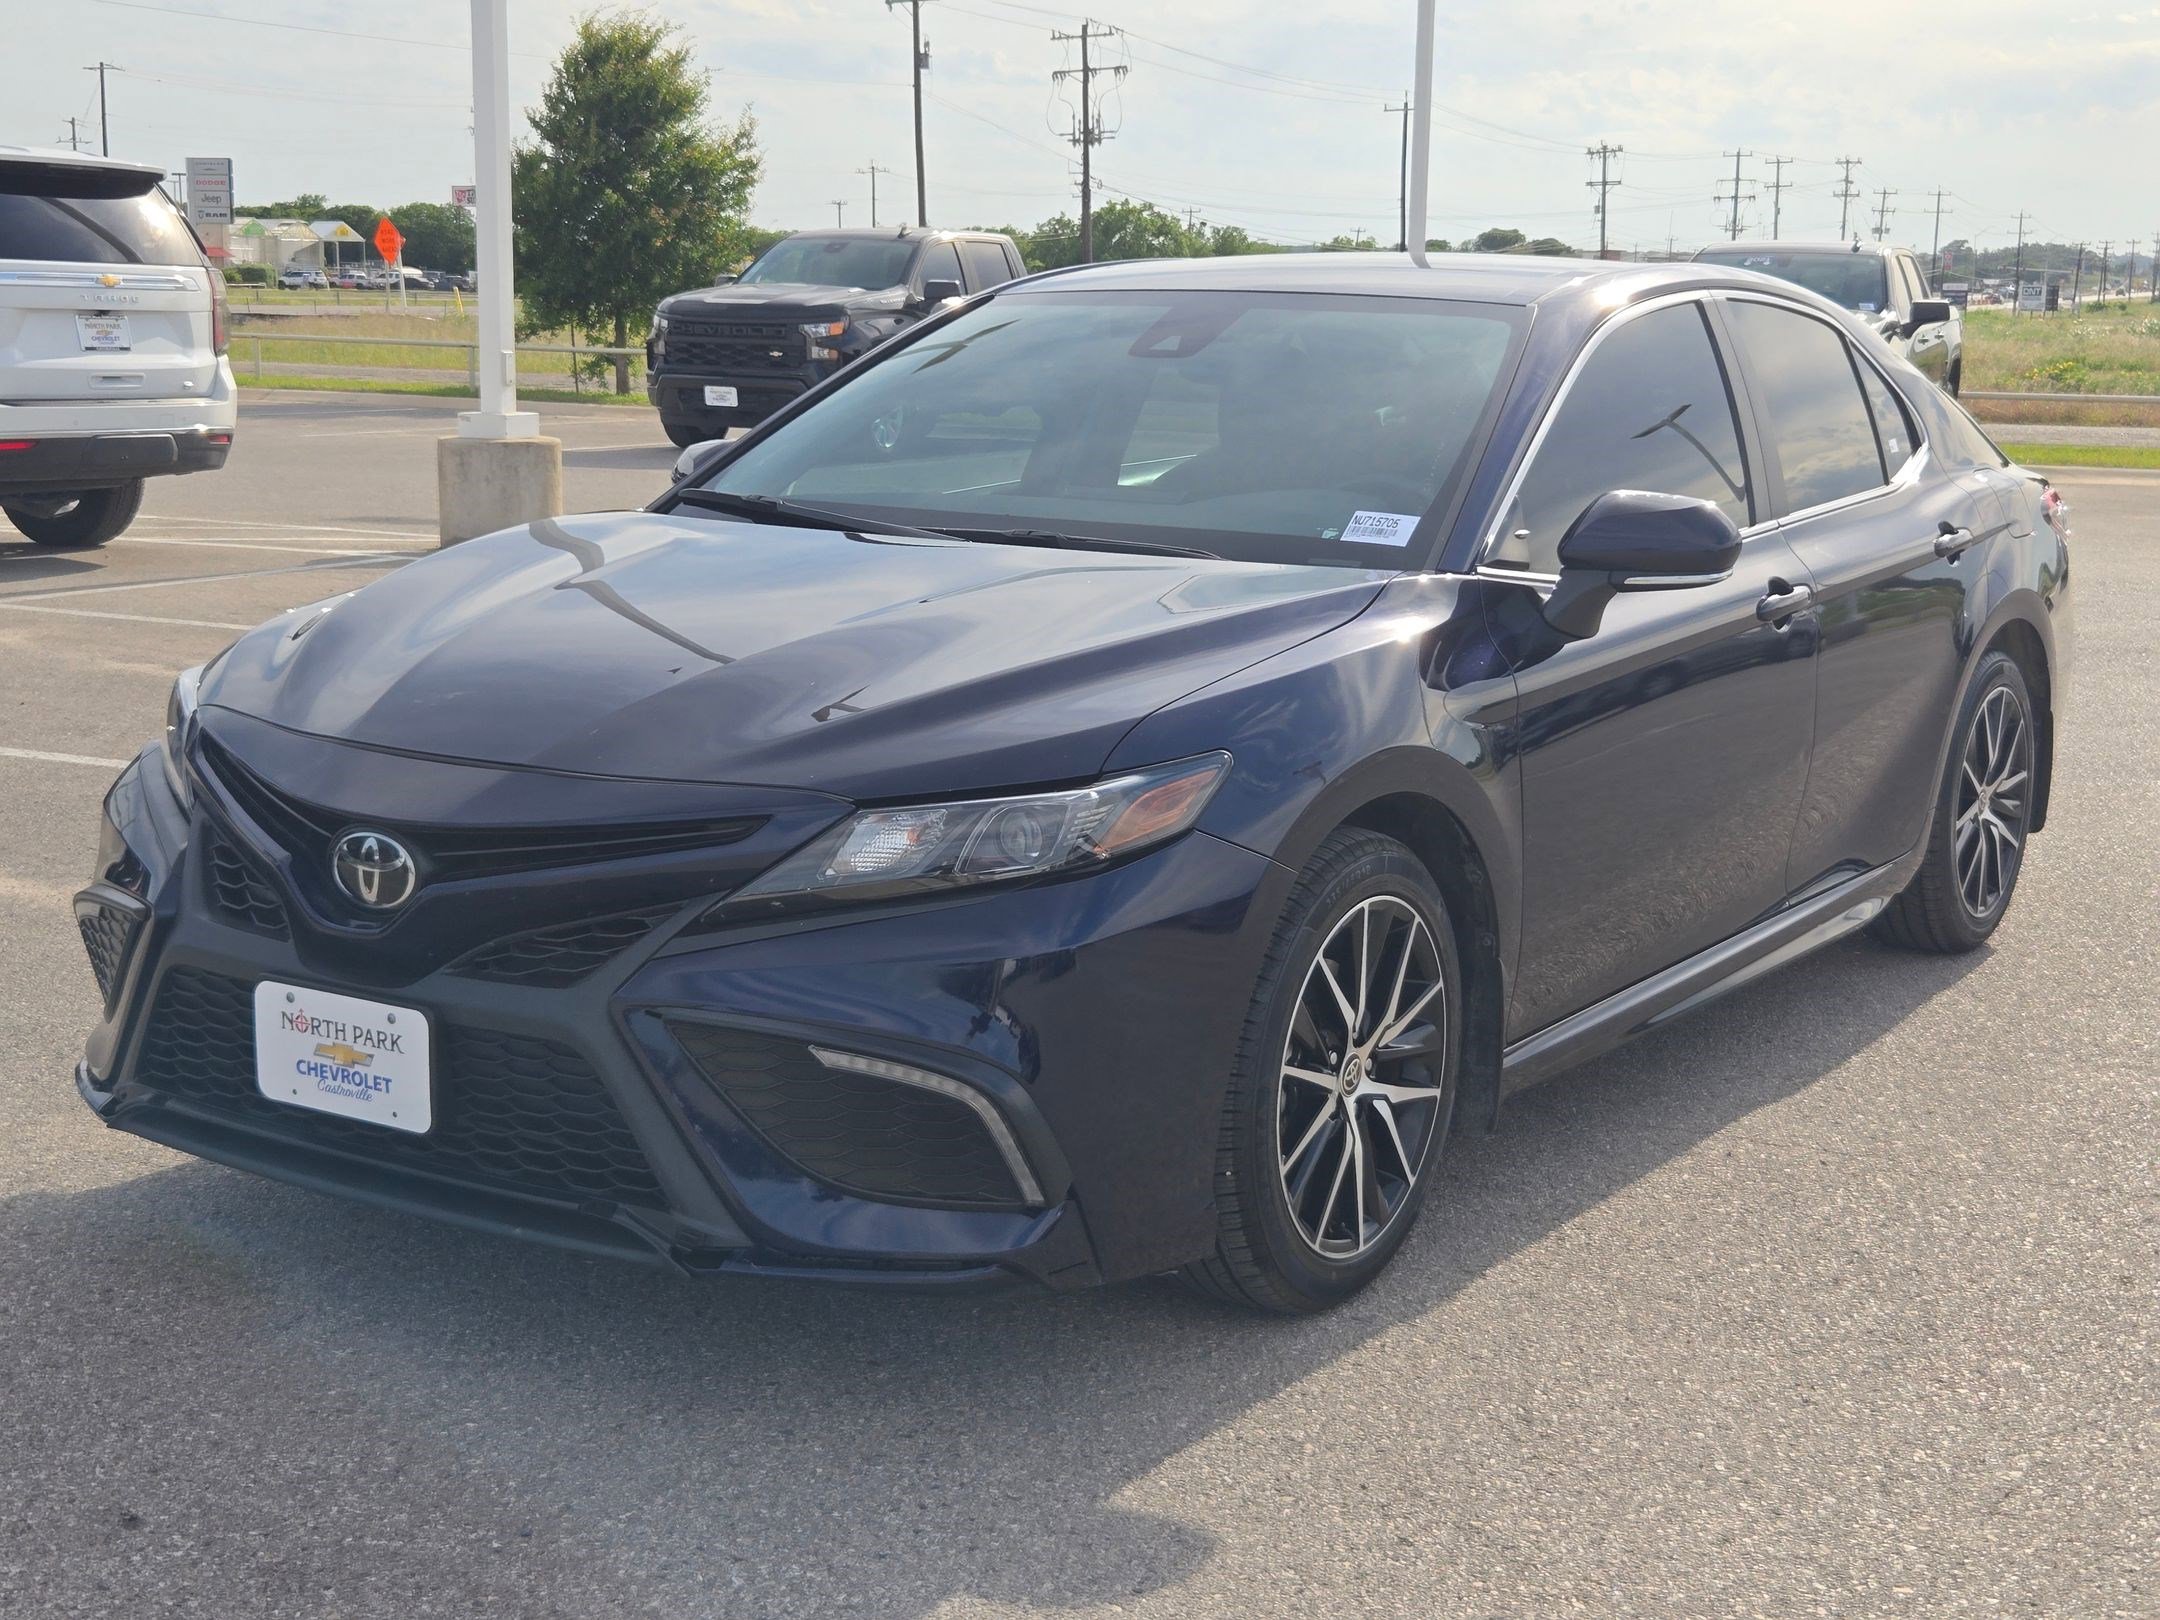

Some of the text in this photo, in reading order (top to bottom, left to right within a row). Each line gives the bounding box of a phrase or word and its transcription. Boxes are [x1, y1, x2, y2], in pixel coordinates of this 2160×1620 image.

[201, 193, 222, 204] Jeep
[669, 323, 786, 337] CHEVROLET
[281, 1009, 405, 1054] NORTH PARK
[296, 1059, 392, 1093] CHEVROLET
[317, 1079, 373, 1102] Castroville
